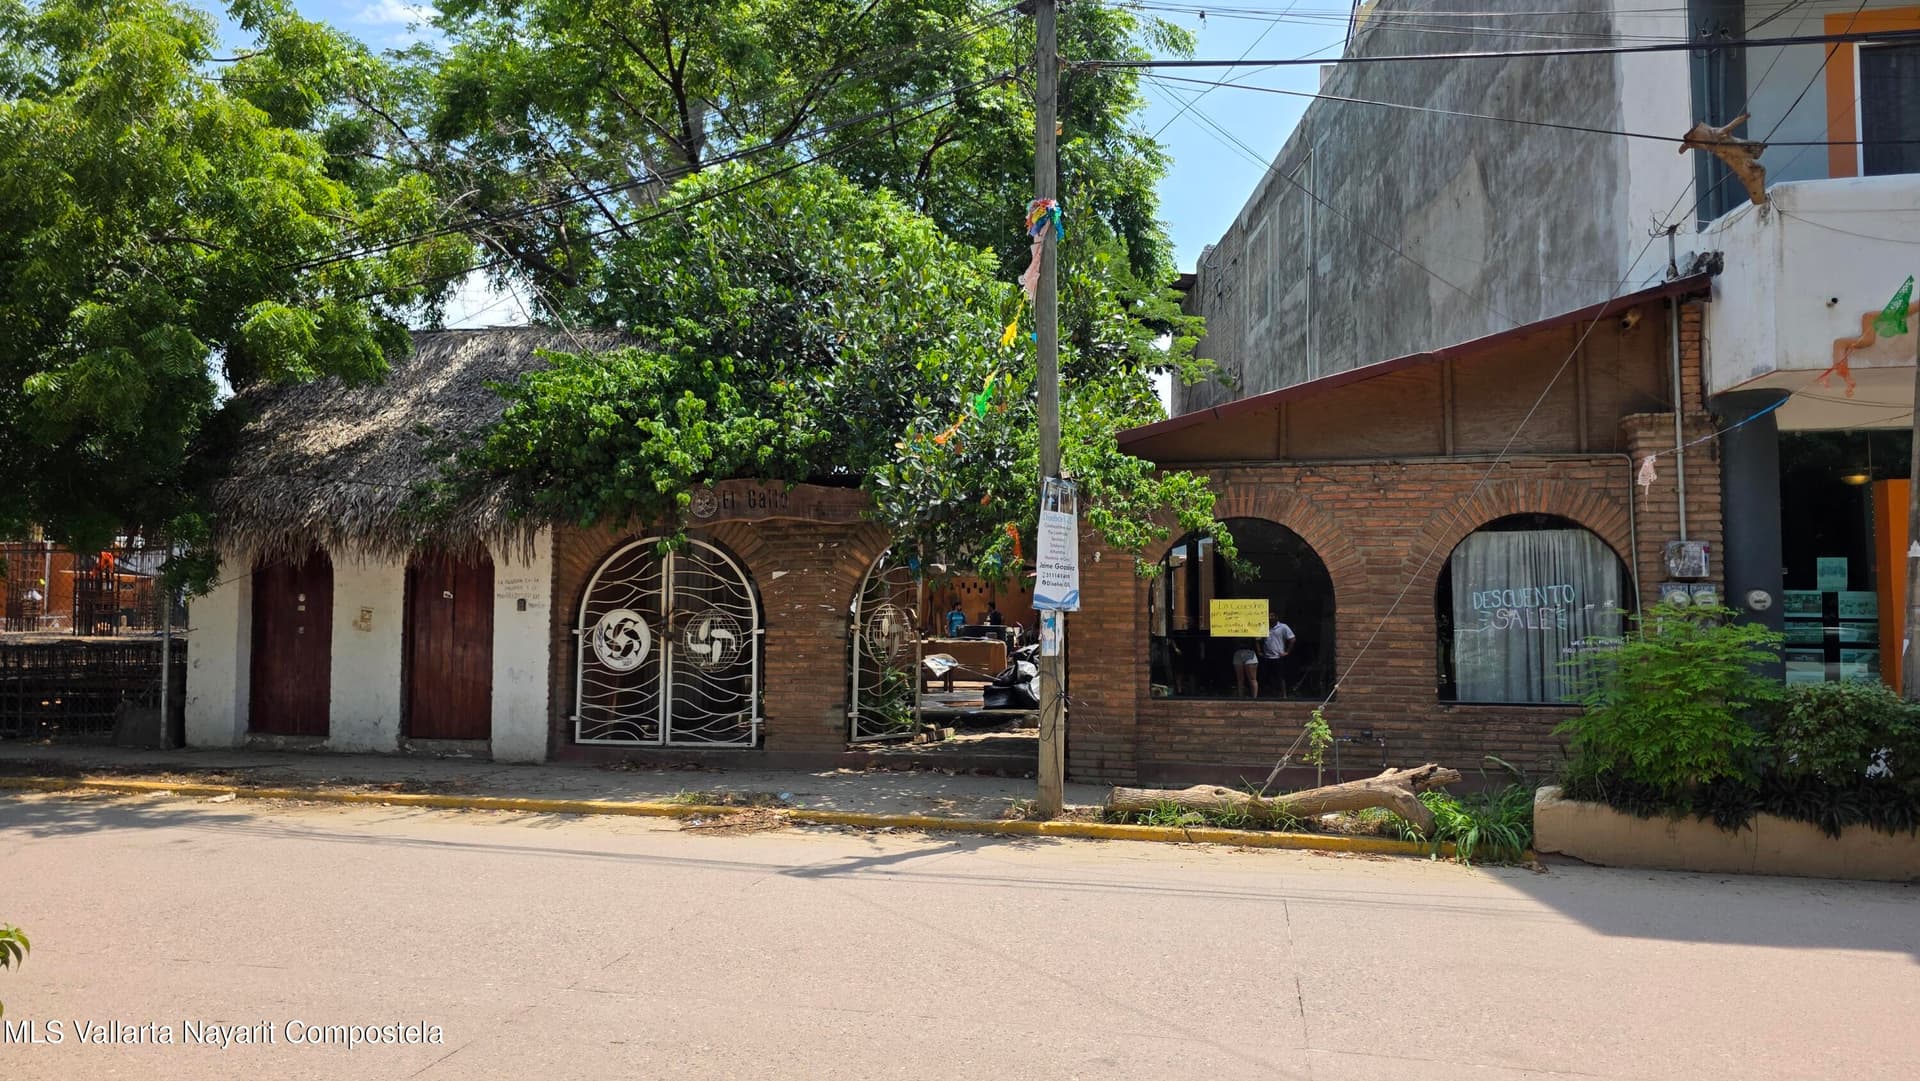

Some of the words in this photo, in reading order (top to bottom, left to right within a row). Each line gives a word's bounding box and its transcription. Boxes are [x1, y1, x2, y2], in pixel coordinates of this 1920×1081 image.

[722, 489, 736, 510] El
[747, 488, 790, 509] Gallo
[1472, 584, 1576, 610] DESCUENTO
[1491, 608, 1556, 630] SALE
